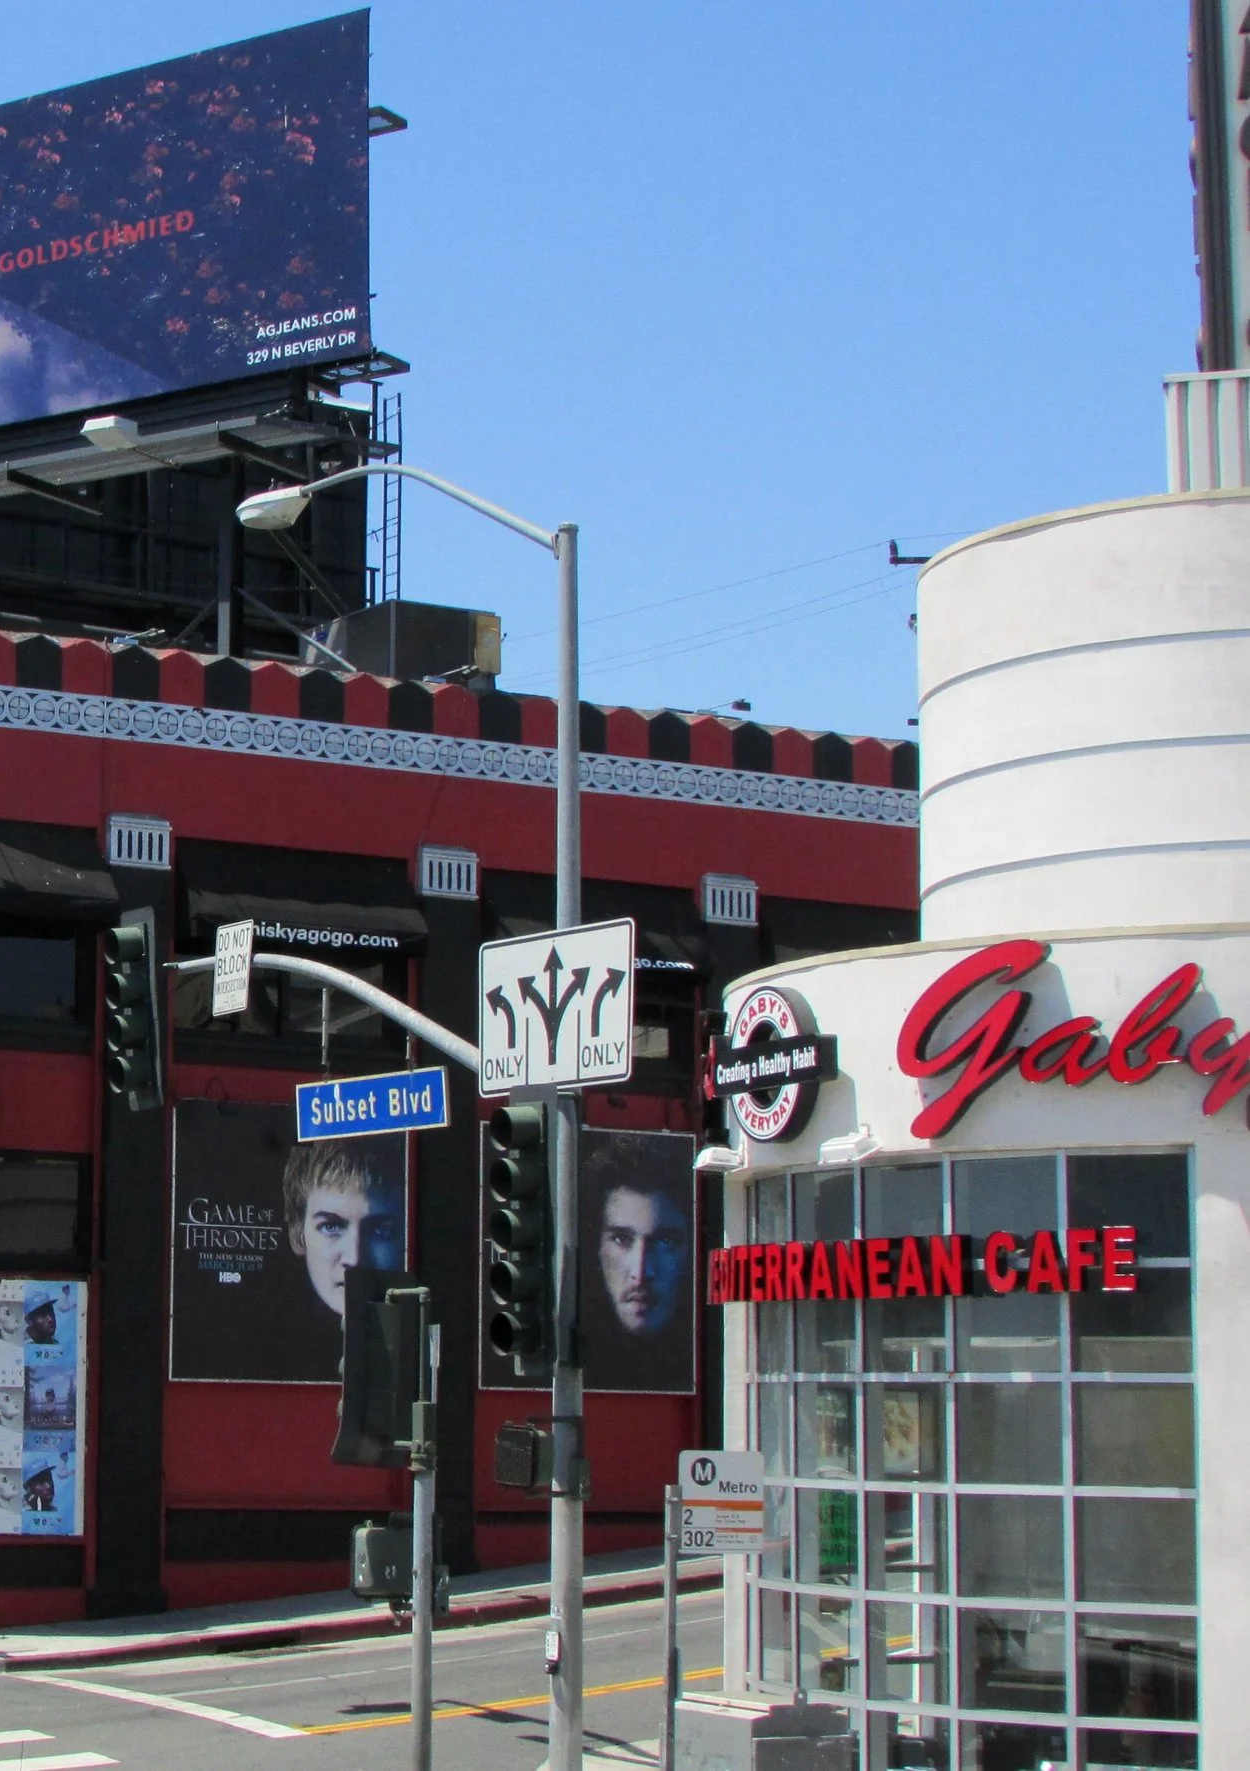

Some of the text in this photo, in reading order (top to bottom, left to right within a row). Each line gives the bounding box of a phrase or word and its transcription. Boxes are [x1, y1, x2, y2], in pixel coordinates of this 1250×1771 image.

[256, 307, 356, 339] AGJEANS.COM
[246, 331, 356, 366] 329 N BEVERLY DR
[218, 927, 250, 952] DO NOT
[252, 922, 398, 948] hiskyagogo.com
[217, 954, 247, 977] BLOCK
[739, 996, 789, 1038] GABY'S
[581, 1041, 625, 1068] ONLY
[716, 1046, 816, 1085] Creating a Healthy Habit
[484, 1055, 524, 1081] ONLY
[311, 1084, 432, 1125] Sunset Blvd
[737, 1091, 791, 1131] EVERYDAY
[188, 1198, 275, 1224] GAME OF
[184, 1224, 279, 1250] THRONES
[199, 1252, 213, 1260] THE
[708, 1226, 1138, 1305] EDITERRANEAN CAFE
[219, 1272, 242, 1283] HBO
[718, 1481, 757, 1493] Metro
[683, 1509, 693, 1525] 2
[683, 1530, 715, 1547] 302
